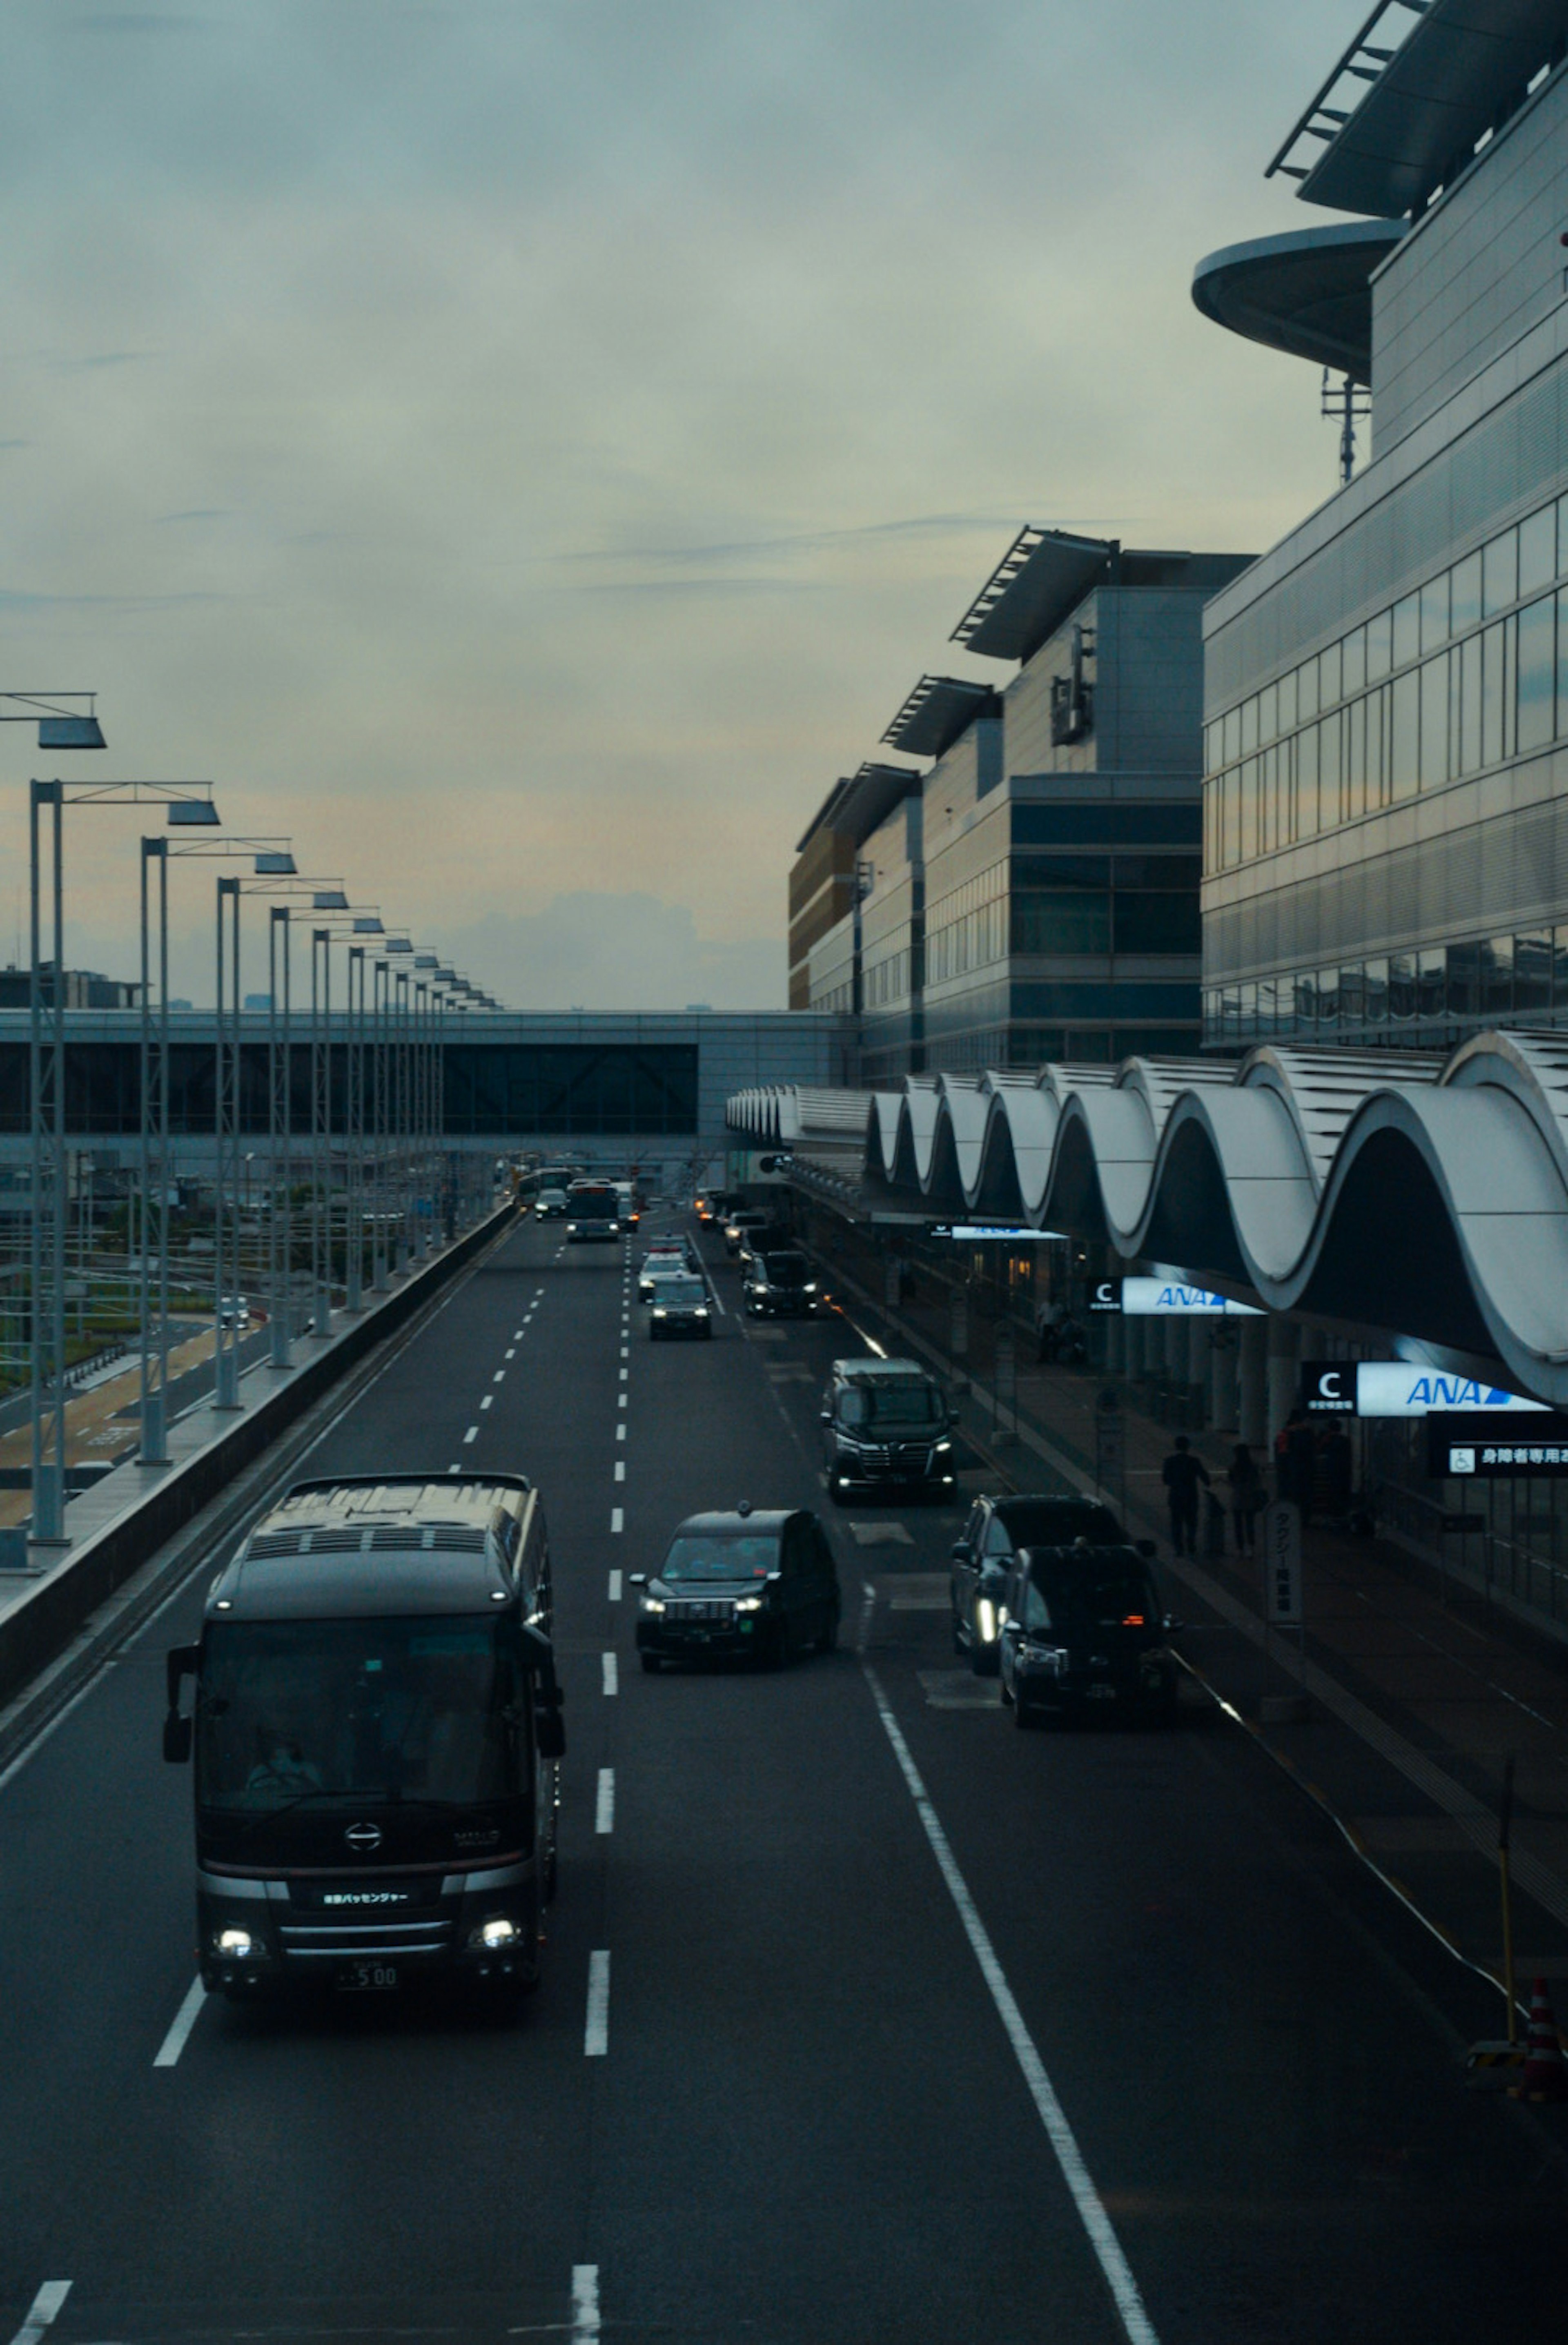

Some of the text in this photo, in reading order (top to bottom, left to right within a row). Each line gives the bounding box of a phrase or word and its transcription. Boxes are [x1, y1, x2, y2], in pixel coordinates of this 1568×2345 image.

[1096, 1283, 1113, 1302] C
[1157, 1287, 1206, 1305] ANA
[1319, 1372, 1341, 1399] C
[1408, 1378, 1480, 1404] ANA
